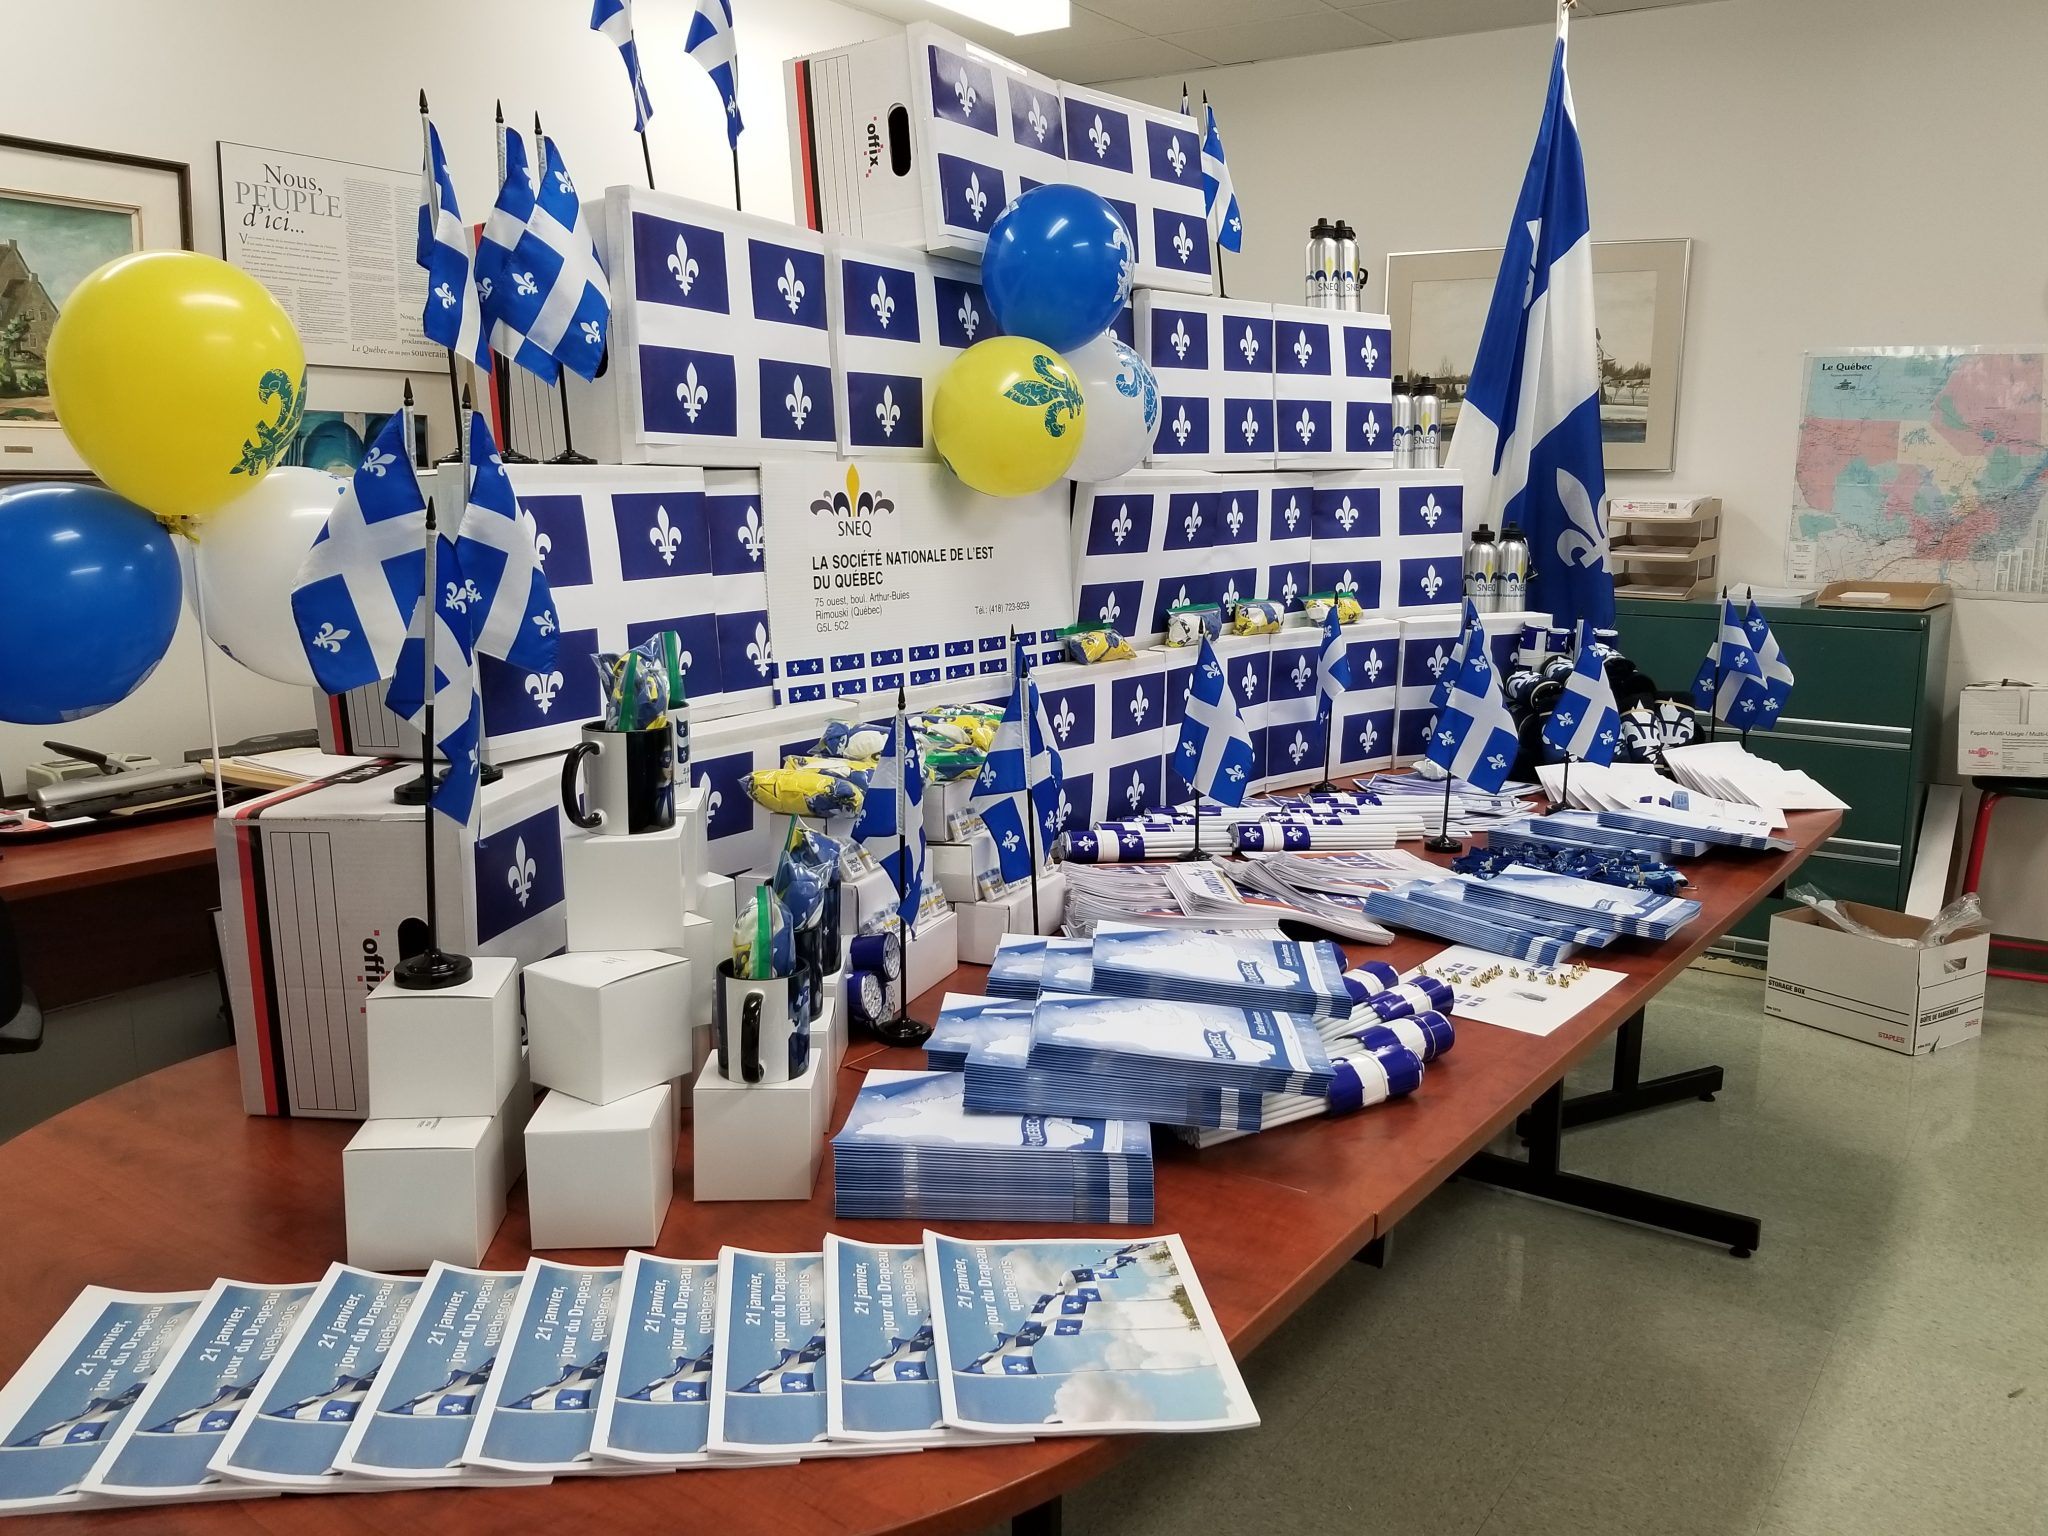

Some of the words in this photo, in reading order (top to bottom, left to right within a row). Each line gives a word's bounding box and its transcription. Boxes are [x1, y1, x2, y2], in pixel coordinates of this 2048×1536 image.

[263, 163, 322, 196] Nous,
[234, 181, 342, 218] PEUPLE
[243, 205, 304, 234] d'ici...
[1318, 282, 1339, 292] SNEQ
[1346, 284, 1360, 292] SNE
[352, 344, 360, 352] Le
[362, 345, 387, 354] Québec
[411, 350, 449, 359] souverain.
[1822, 363, 1833, 371] Le
[1836, 362, 1872, 371] Québec
[1414, 436, 1436, 445] SNEQ
[838, 520, 872, 538] SNEQ
[812, 556, 828, 570] LA
[832, 549, 882, 569] SOCIÉTÉ
[886, 549, 946, 565] NATIONALE
[950, 548, 964, 561] DE
[967, 546, 994, 560] L'EST
[813, 575, 830, 590] DU
[834, 569, 883, 588] QUÉBEC
[815, 598, 824, 607] 75
[826, 596, 848, 606] ouest,
[850, 594, 868, 604] boul.
[870, 590, 910, 602] Arthur-Buies
[989, 604, 1003, 615] (418)
[1005, 601, 1030, 612] 723-9259
[816, 608, 848, 620] Rimouski
[850, 605, 882, 618] (Québec)
[816, 622, 832, 633] G5L
[834, 620, 849, 631] 5C2
[1768, 979, 1793, 991] STORAGE
[1794, 987, 1806, 995] BOX
[1878, 1031, 1905, 1044] STAPLES
[877, 1251, 893, 1291] Drapeau
[953, 1259, 974, 1294] janvier,
[976, 1248, 992, 1286] Drapeau
[673, 1268, 693, 1309] Drapeau
[746, 1273, 765, 1310] janvier,
[771, 1261, 789, 1302] Drapeau
[853, 1262, 872, 1300] janvier,
[899, 1264, 922, 1315] québécois
[999, 1261, 1024, 1311] québécois
[358, 1283, 394, 1326] Drapeau
[464, 1279, 496, 1321] Drapeau
[540, 1286, 568, 1325] janvier,
[568, 1274, 593, 1316] Drapeau
[647, 1280, 670, 1317] janvier,
[796, 1274, 814, 1326] québécois
[878, 1294, 893, 1307] du
[957, 1295, 972, 1309] 21
[981, 1290, 995, 1302] du
[242, 1292, 280, 1336] Drapeau
[327, 1294, 365, 1333] janvier,
[435, 1291, 468, 1330] janvier,
[591, 1288, 613, 1341] québécois
[671, 1312, 687, 1325] du
[697, 1281, 714, 1334] québécois
[746, 1312, 760, 1326] 21
[771, 1305, 785, 1317] du
[854, 1301, 869, 1315] 21
[985, 1304, 1003, 1326] jour
[120, 1306, 163, 1349] Drapeau
[210, 1306, 250, 1346] janvier,
[375, 1297, 411, 1352] québécois
[459, 1324, 477, 1337] du
[484, 1292, 514, 1347] québécois
[564, 1320, 581, 1332] du
[644, 1319, 660, 1333] 21
[770, 1320, 790, 1342] jour
[880, 1309, 899, 1331] jour
[259, 1305, 298, 1360] québécois
[318, 1334, 338, 1349] 21
[351, 1329, 370, 1342] du
[427, 1331, 446, 1345] 21
[535, 1327, 552, 1340] 21
[668, 1328, 687, 1350] jour
[75, 1363, 97, 1375] 21
[87, 1320, 132, 1359] janvier,
[133, 1318, 177, 1373] québécois
[200, 1348, 221, 1362] 21
[234, 1339, 254, 1352] du
[335, 1345, 360, 1368] jour
[446, 1340, 469, 1363] jour
[556, 1335, 576, 1358] jour
[111, 1352, 131, 1366] du
[217, 1356, 244, 1379] jour
[90, 1369, 118, 1392] jour
